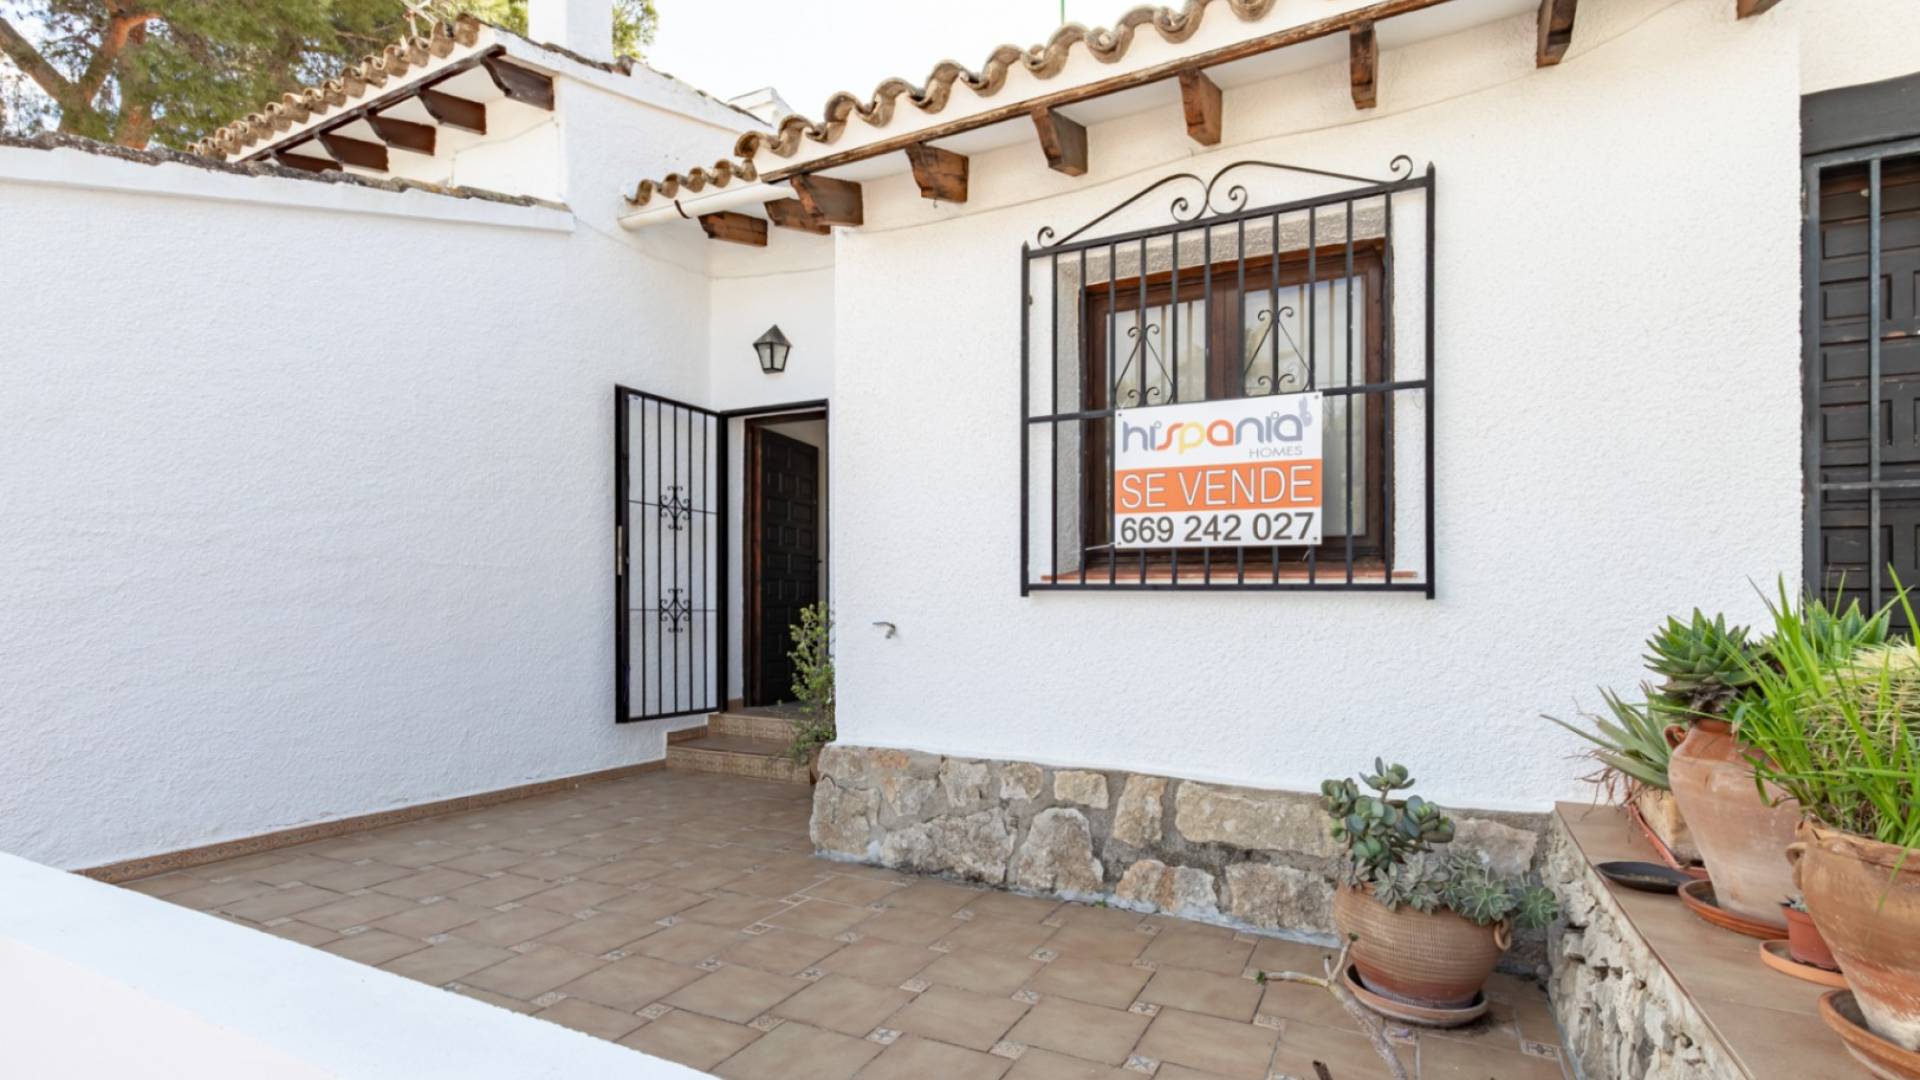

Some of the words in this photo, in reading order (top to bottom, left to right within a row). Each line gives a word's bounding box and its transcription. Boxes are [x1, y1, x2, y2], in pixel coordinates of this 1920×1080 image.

[1122, 411, 1303, 454] hispania
[1249, 446, 1303, 459] HOMES
[1121, 473, 1167, 509] SE
[1178, 465, 1313, 506] VENDE
[1120, 516, 1174, 544] 669
[1183, 513, 1242, 542] 242
[1252, 512, 1314, 541] 027
